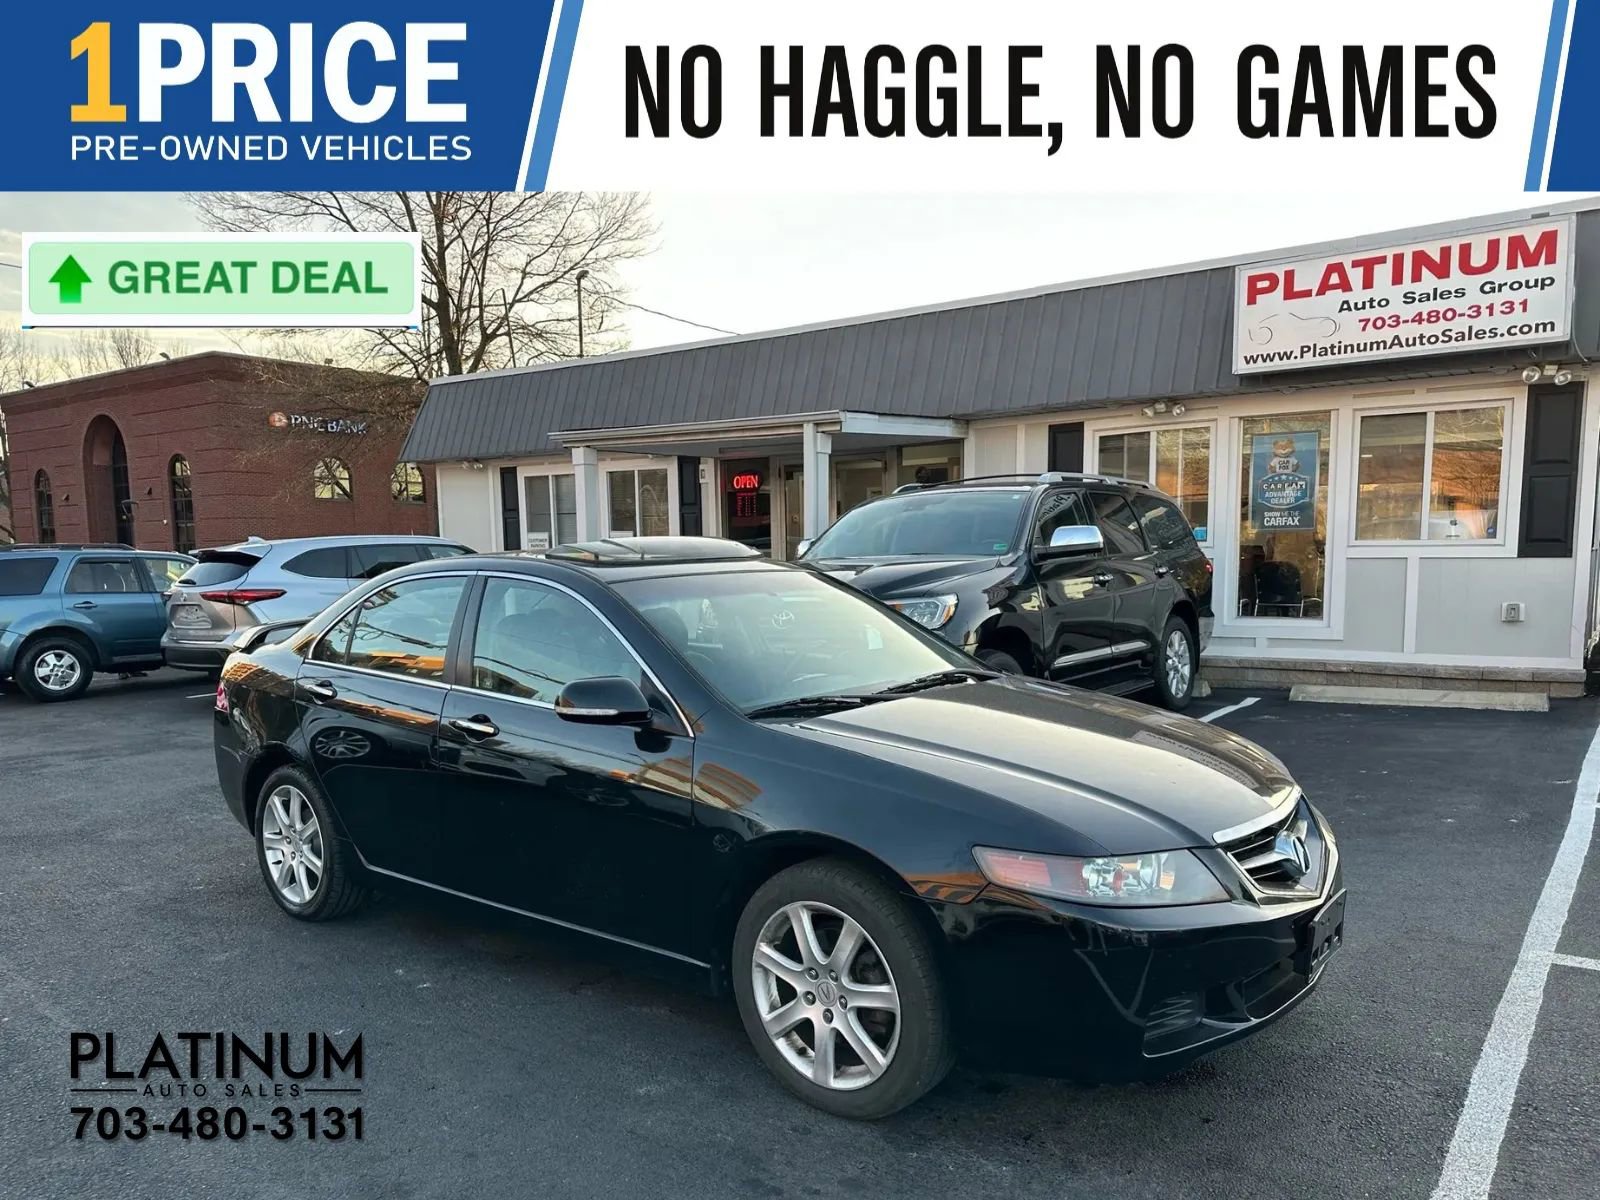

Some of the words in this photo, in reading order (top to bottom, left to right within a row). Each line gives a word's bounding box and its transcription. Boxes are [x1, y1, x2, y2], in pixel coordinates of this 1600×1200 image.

[1246, 229, 1558, 306] PLATINUM
[1338, 297, 1390, 313] Auto
[1402, 285, 1467, 305] Sales
[1479, 275, 1556, 296] Group
[1358, 298, 1529, 332] 703-480-3131
[1243, 320, 1556, 365] www.PlatinumAutoSales.com
[733, 475, 759, 489] OPEN
[1263, 482, 1305, 490] CARFAX
[1264, 490, 1302, 498] ADVANTAGE
[1264, 517, 1300, 526] CARFAX
